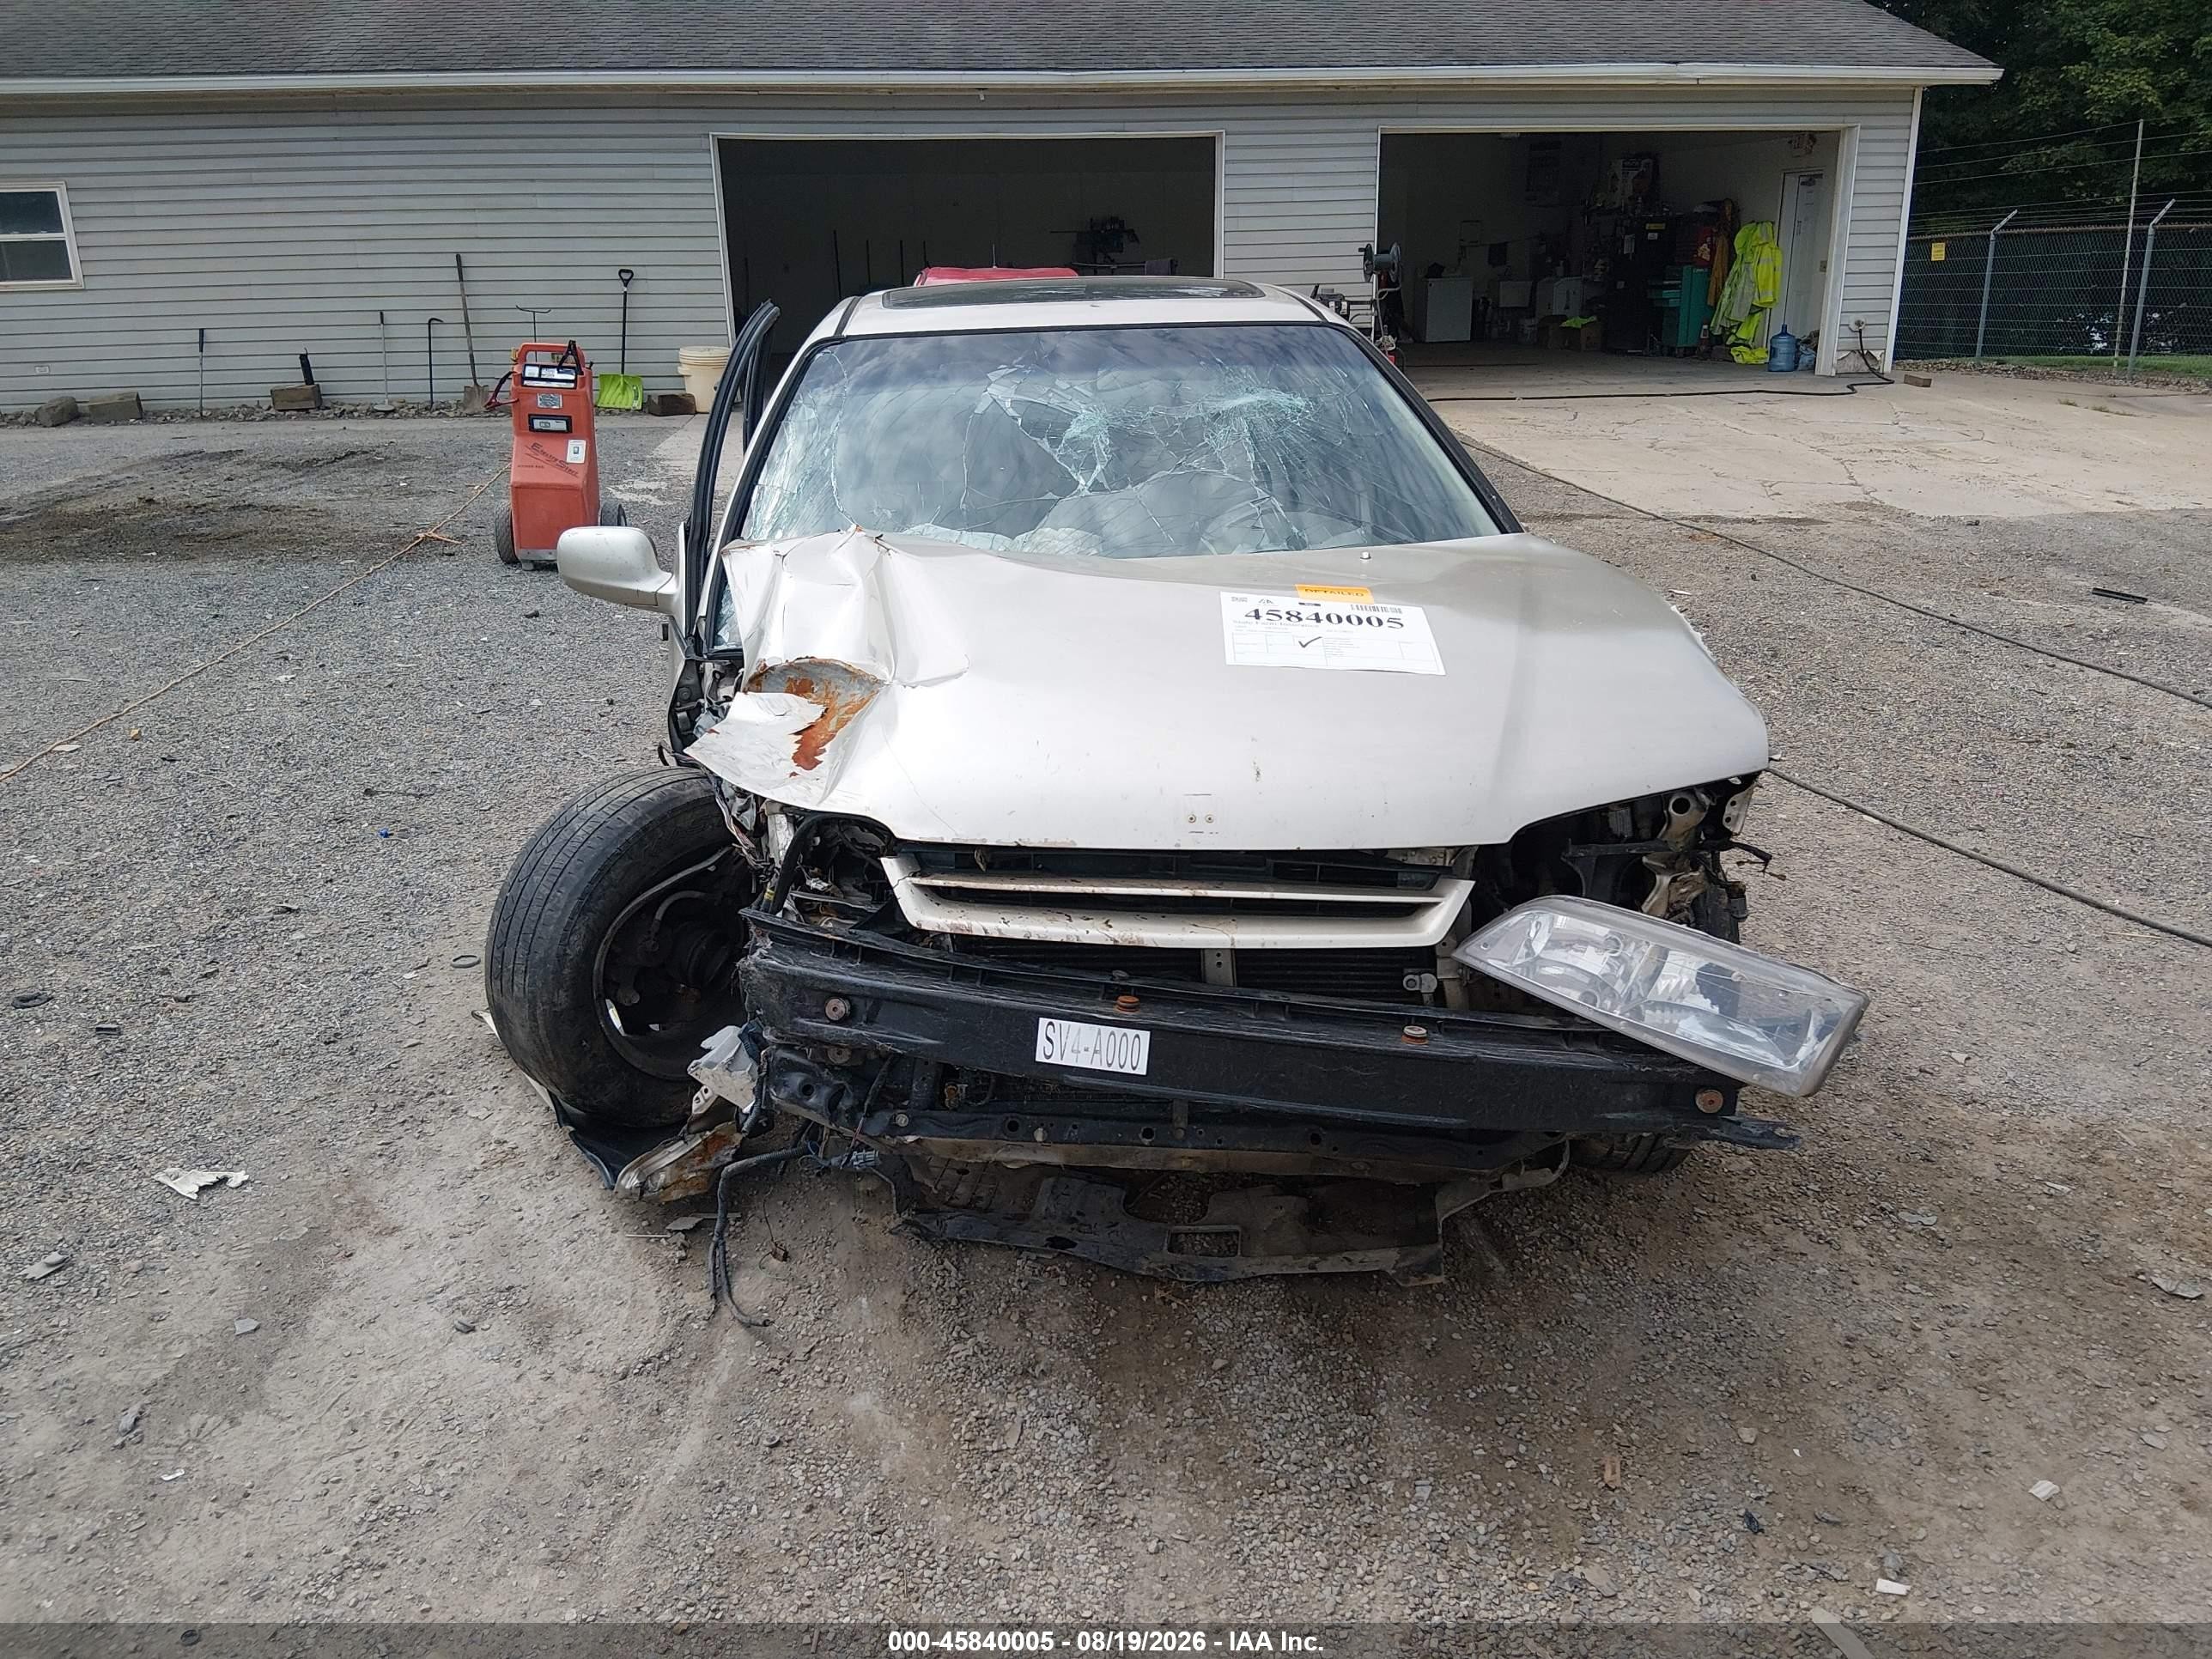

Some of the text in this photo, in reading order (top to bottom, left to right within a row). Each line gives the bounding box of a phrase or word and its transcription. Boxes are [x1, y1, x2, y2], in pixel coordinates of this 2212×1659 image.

[1304, 588, 1365, 598] DETAILED
[1244, 608, 1404, 629] 45840005
[1042, 1021, 1140, 1071] SV4-A000
